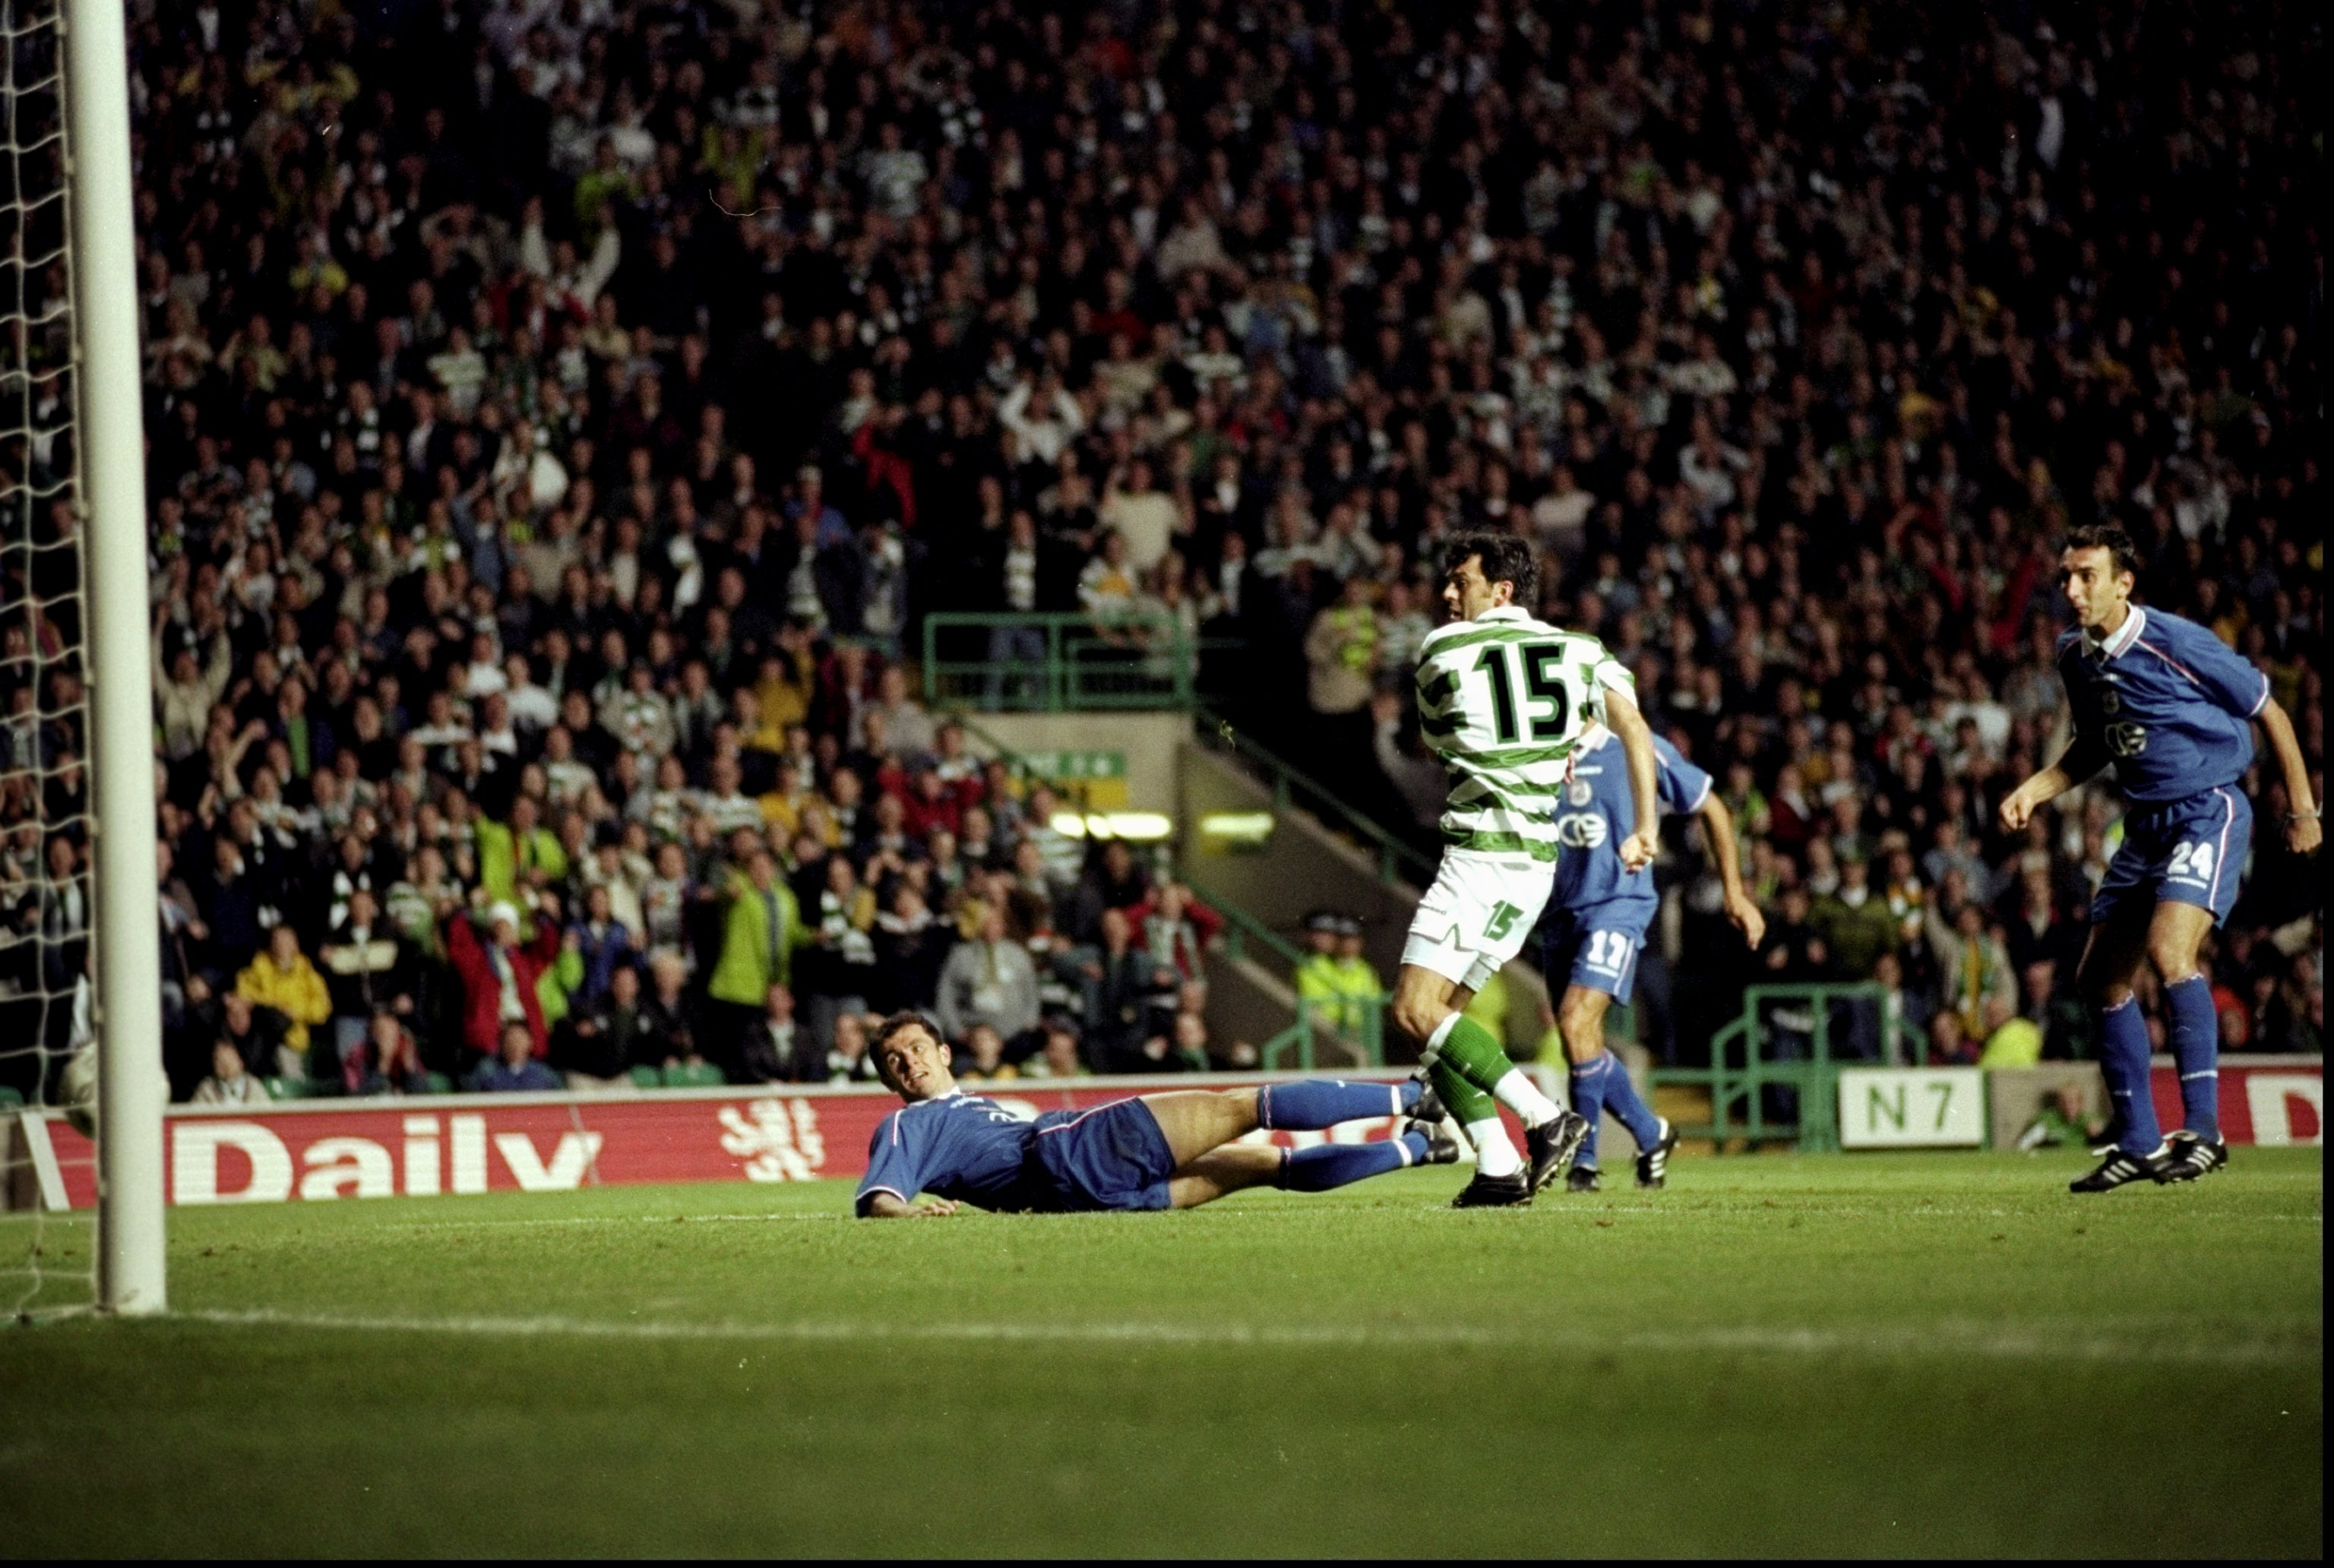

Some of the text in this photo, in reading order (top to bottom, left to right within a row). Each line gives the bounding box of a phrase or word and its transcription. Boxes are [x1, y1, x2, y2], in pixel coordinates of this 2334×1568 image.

[1472, 641, 1570, 744] 15
[2167, 840, 2213, 881] 24
[1482, 899, 1525, 942] 15
[1868, 1081, 1953, 1132] N 7
